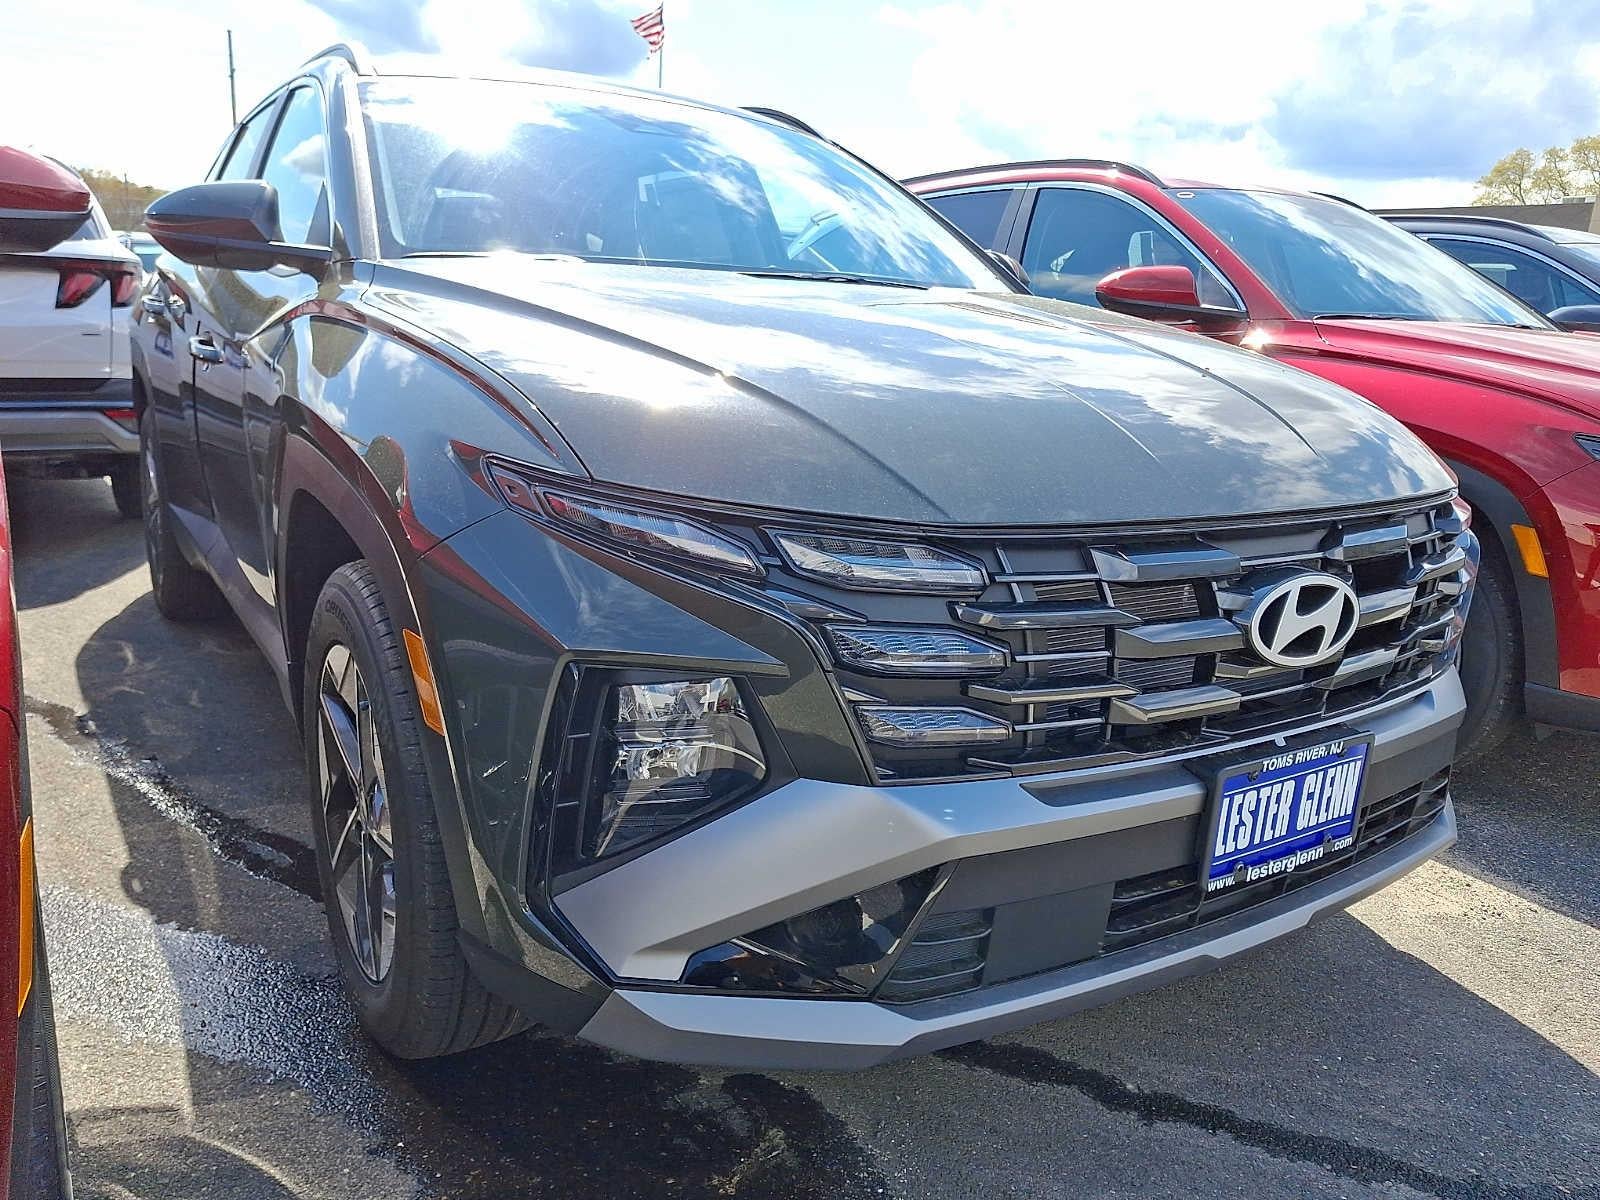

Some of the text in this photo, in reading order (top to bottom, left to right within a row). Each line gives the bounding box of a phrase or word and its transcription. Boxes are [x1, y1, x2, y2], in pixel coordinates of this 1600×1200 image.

[1262, 754, 1294, 772] TOMS
[1330, 742, 1344, 756] NJ
[1214, 760, 1362, 858] LESTER GLENN
[1246, 846, 1324, 882] lesterglenn
